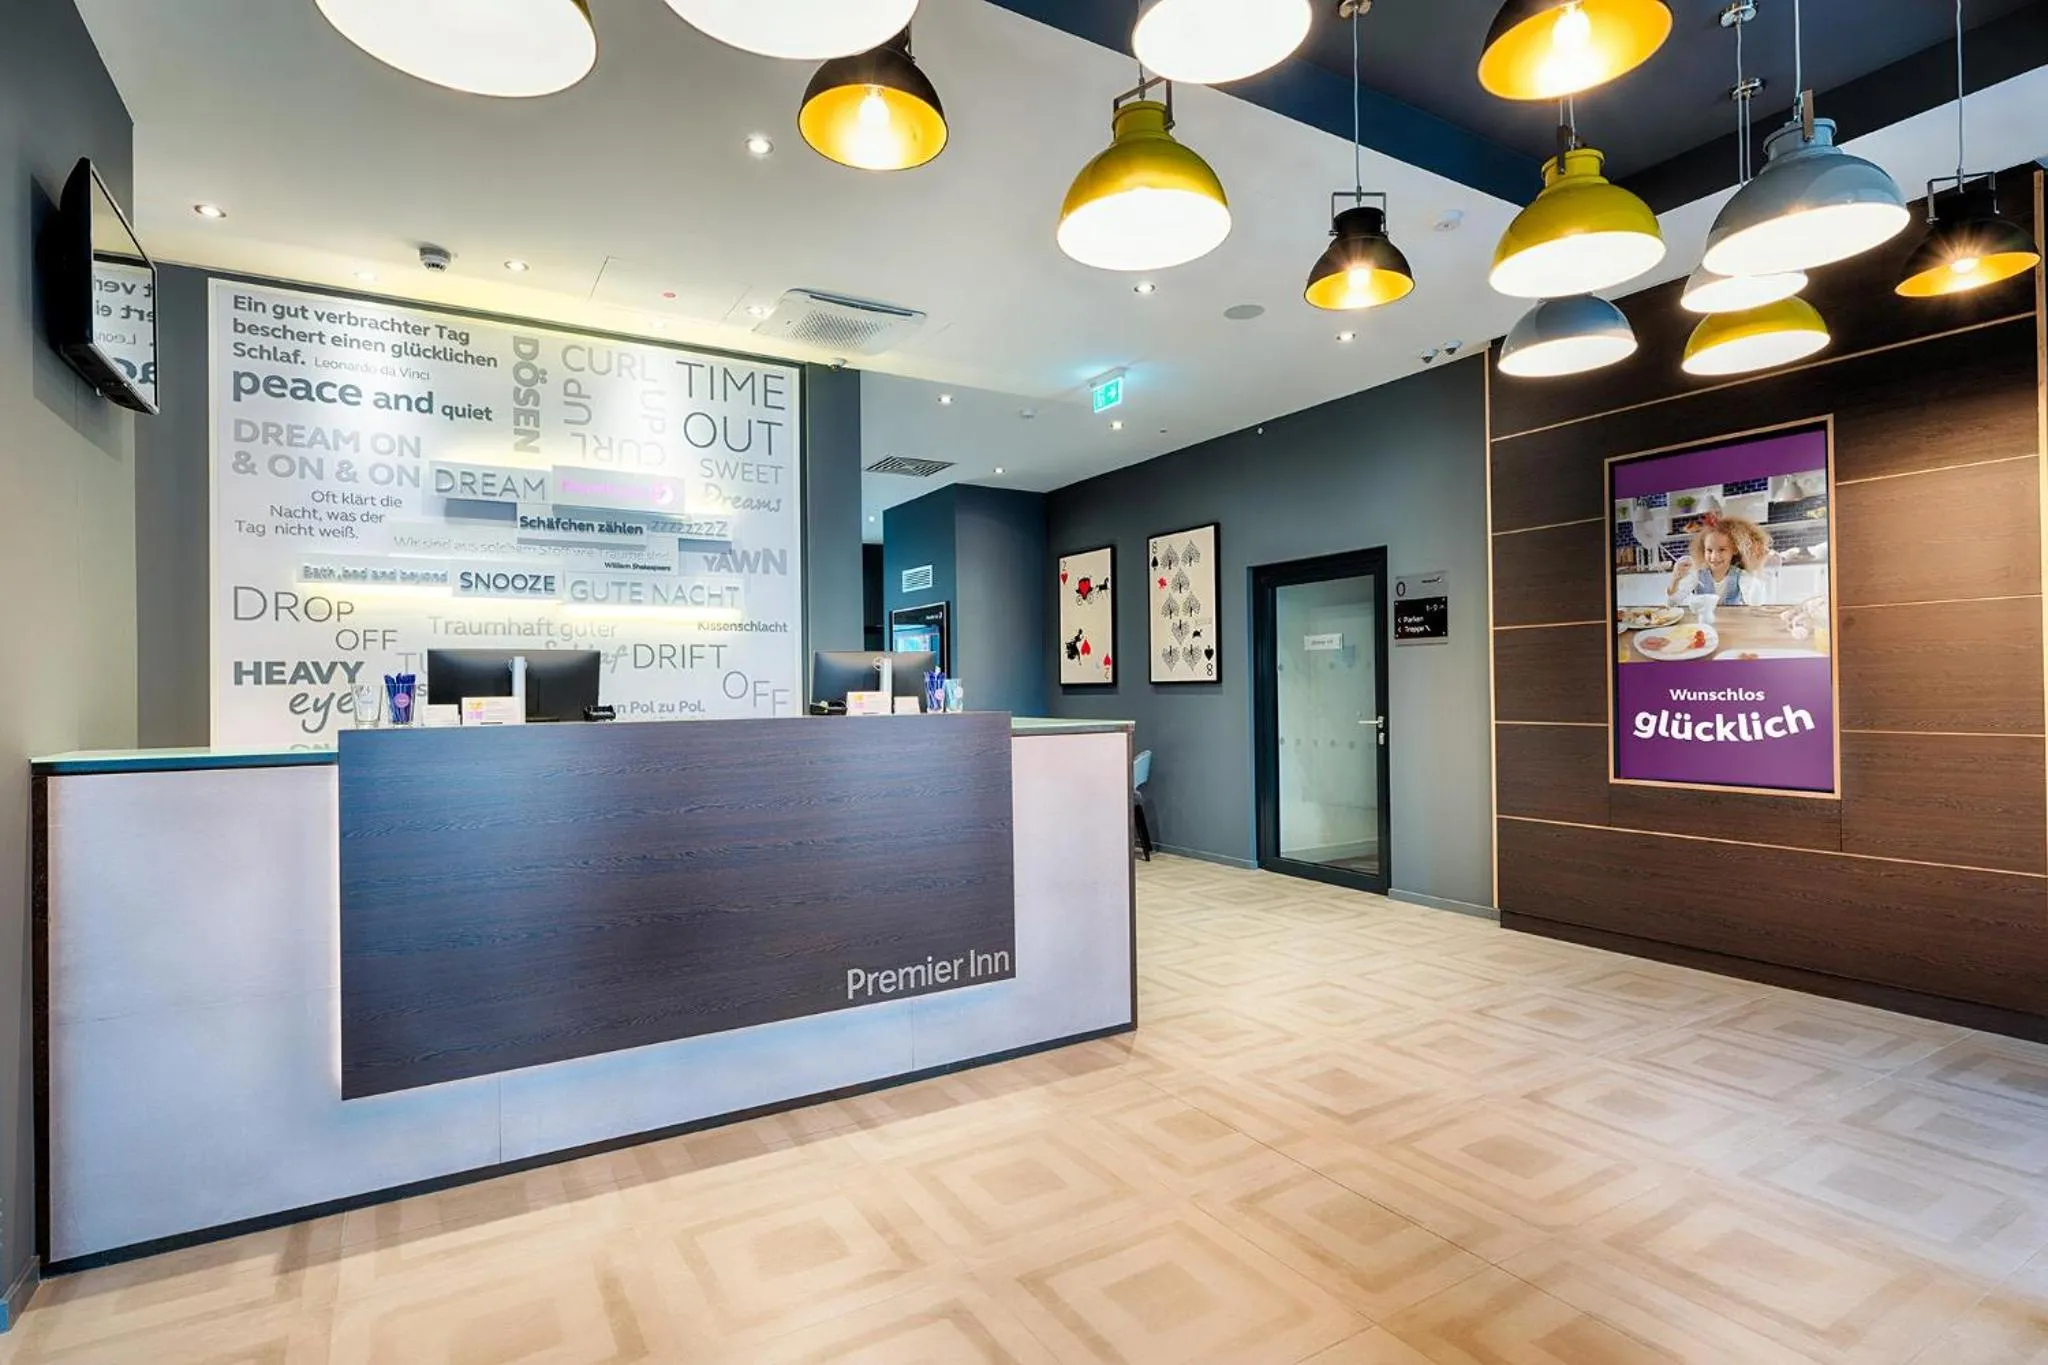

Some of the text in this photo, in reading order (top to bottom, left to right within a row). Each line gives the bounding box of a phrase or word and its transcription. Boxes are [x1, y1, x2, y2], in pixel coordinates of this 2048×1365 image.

[233, 294, 470, 346] Ein gut verbrachter Tag
[233, 318, 498, 368] beschert einen glücklichen
[232, 341, 430, 380] Schlaf. Leonardo da Vinci
[562, 345, 657, 382] CURL
[233, 369, 493, 423] peace and quiet
[513, 335, 546, 454] DÖSEN
[563, 378, 592, 426] UP
[676, 360, 785, 411] TIME
[641, 390, 666, 435] UP
[233, 418, 421, 458] DREAM ON
[570, 432, 666, 466] CURL
[683, 411, 783, 456] OUT
[232, 450, 421, 488] & ON & ON
[434, 468, 545, 500] DREAM
[700, 458, 784, 484] SWEET
[311, 490, 403, 508] Oft klärt die
[705, 482, 781, 512] Dreams
[234, 520, 359, 540] Tag nicht weiß.
[270, 505, 385, 523] Nacht, was der
[519, 515, 643, 536] Schäfchen zählen
[703, 548, 787, 576] YAWN
[460, 571, 555, 593] SNOOZE
[570, 580, 740, 608] GUTE NACHT
[233, 585, 354, 622] DROP
[335, 629, 399, 651] OFF
[428, 616, 616, 641] Traumhaft guter
[697, 620, 788, 633] Kissenschlacht
[633, 643, 727, 669] DRIFT
[234, 661, 365, 686] HEAVY
[631, 700, 656, 714] Pol
[658, 702, 675, 713] zu
[722, 670, 789, 716] OFF
[1669, 688, 1765, 701] Wunschlos
[1633, 704, 1815, 742] glücklich
[848, 949, 1010, 999] Premier Inn
